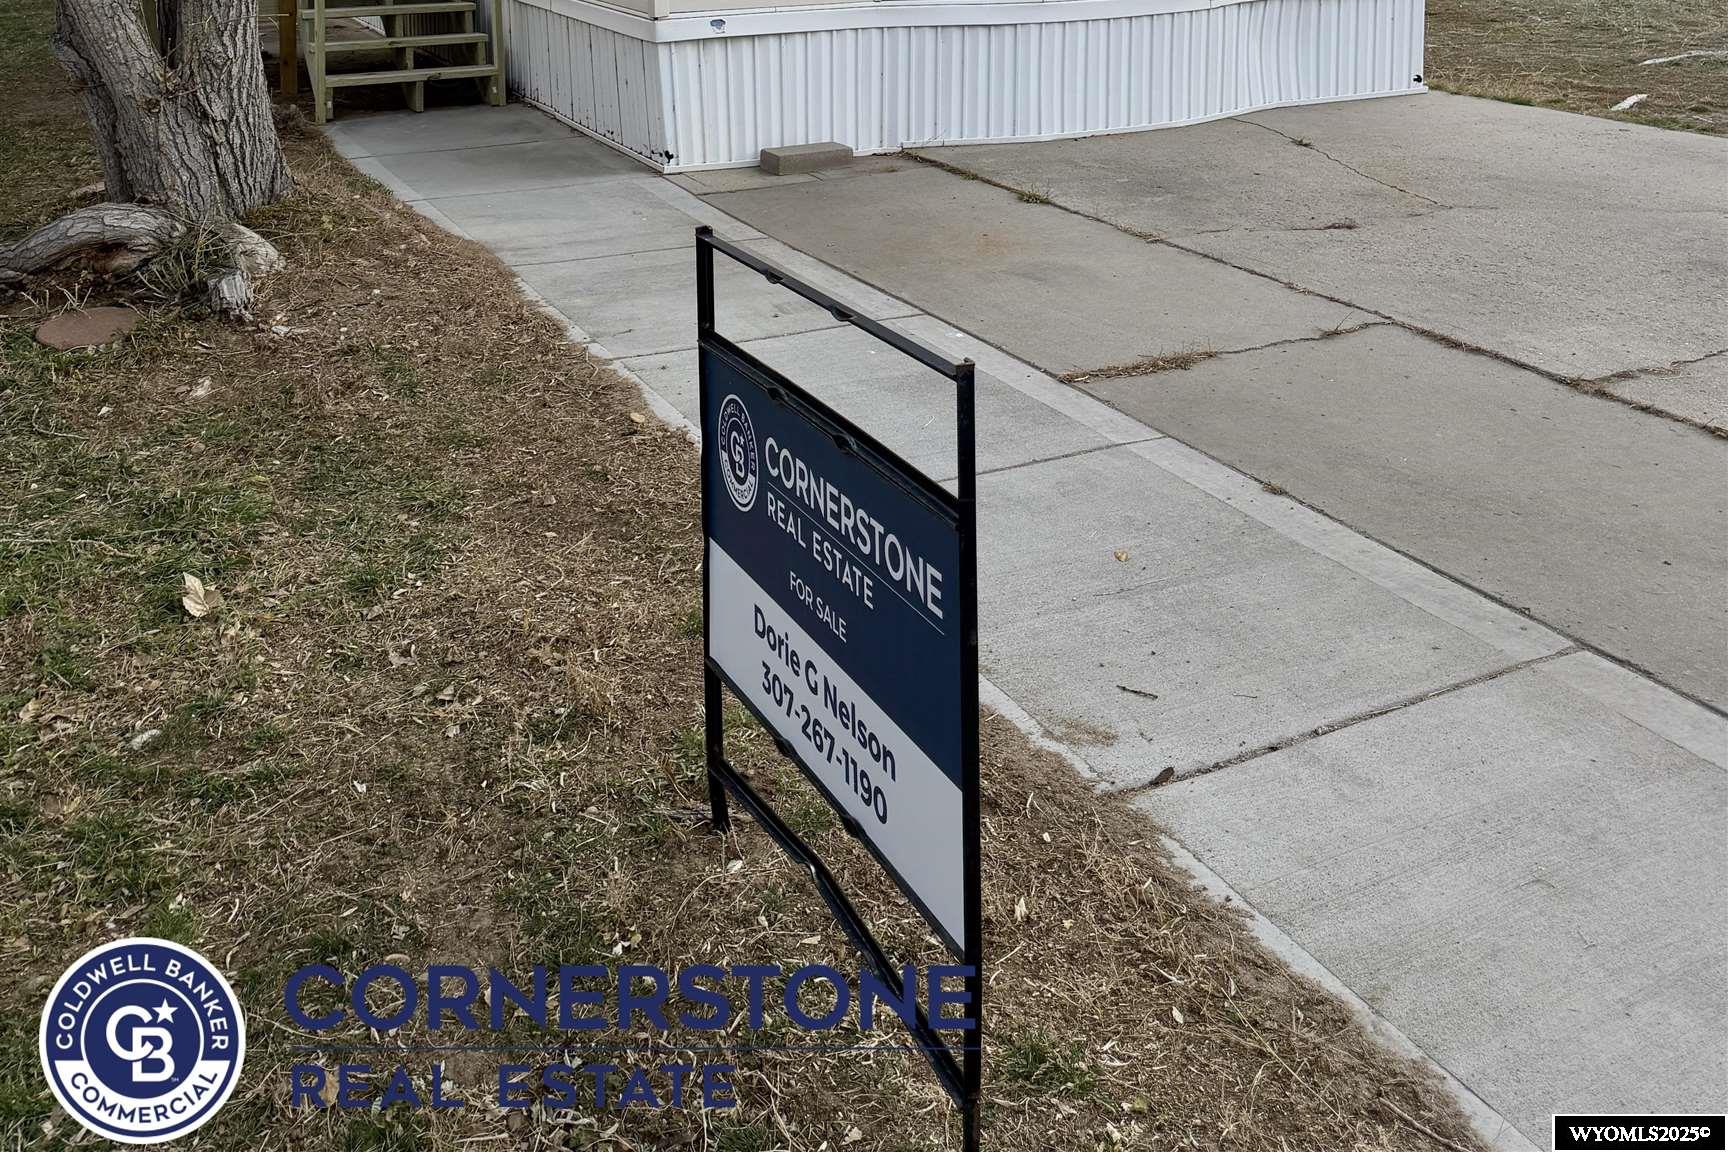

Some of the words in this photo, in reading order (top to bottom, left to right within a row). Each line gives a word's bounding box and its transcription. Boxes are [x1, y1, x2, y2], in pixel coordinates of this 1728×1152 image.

[765, 437, 944, 620] CORNERSTONE
[767, 491, 806, 548] REAL
[813, 531, 874, 610] ESTATE
[789, 570, 814, 612] FOR
[816, 597, 847, 643] SALE
[754, 604, 801, 677] Dorie
[804, 659, 819, 696] G
[824, 675, 896, 782] Nelson
[762, 661, 888, 825] 307-267-1190
